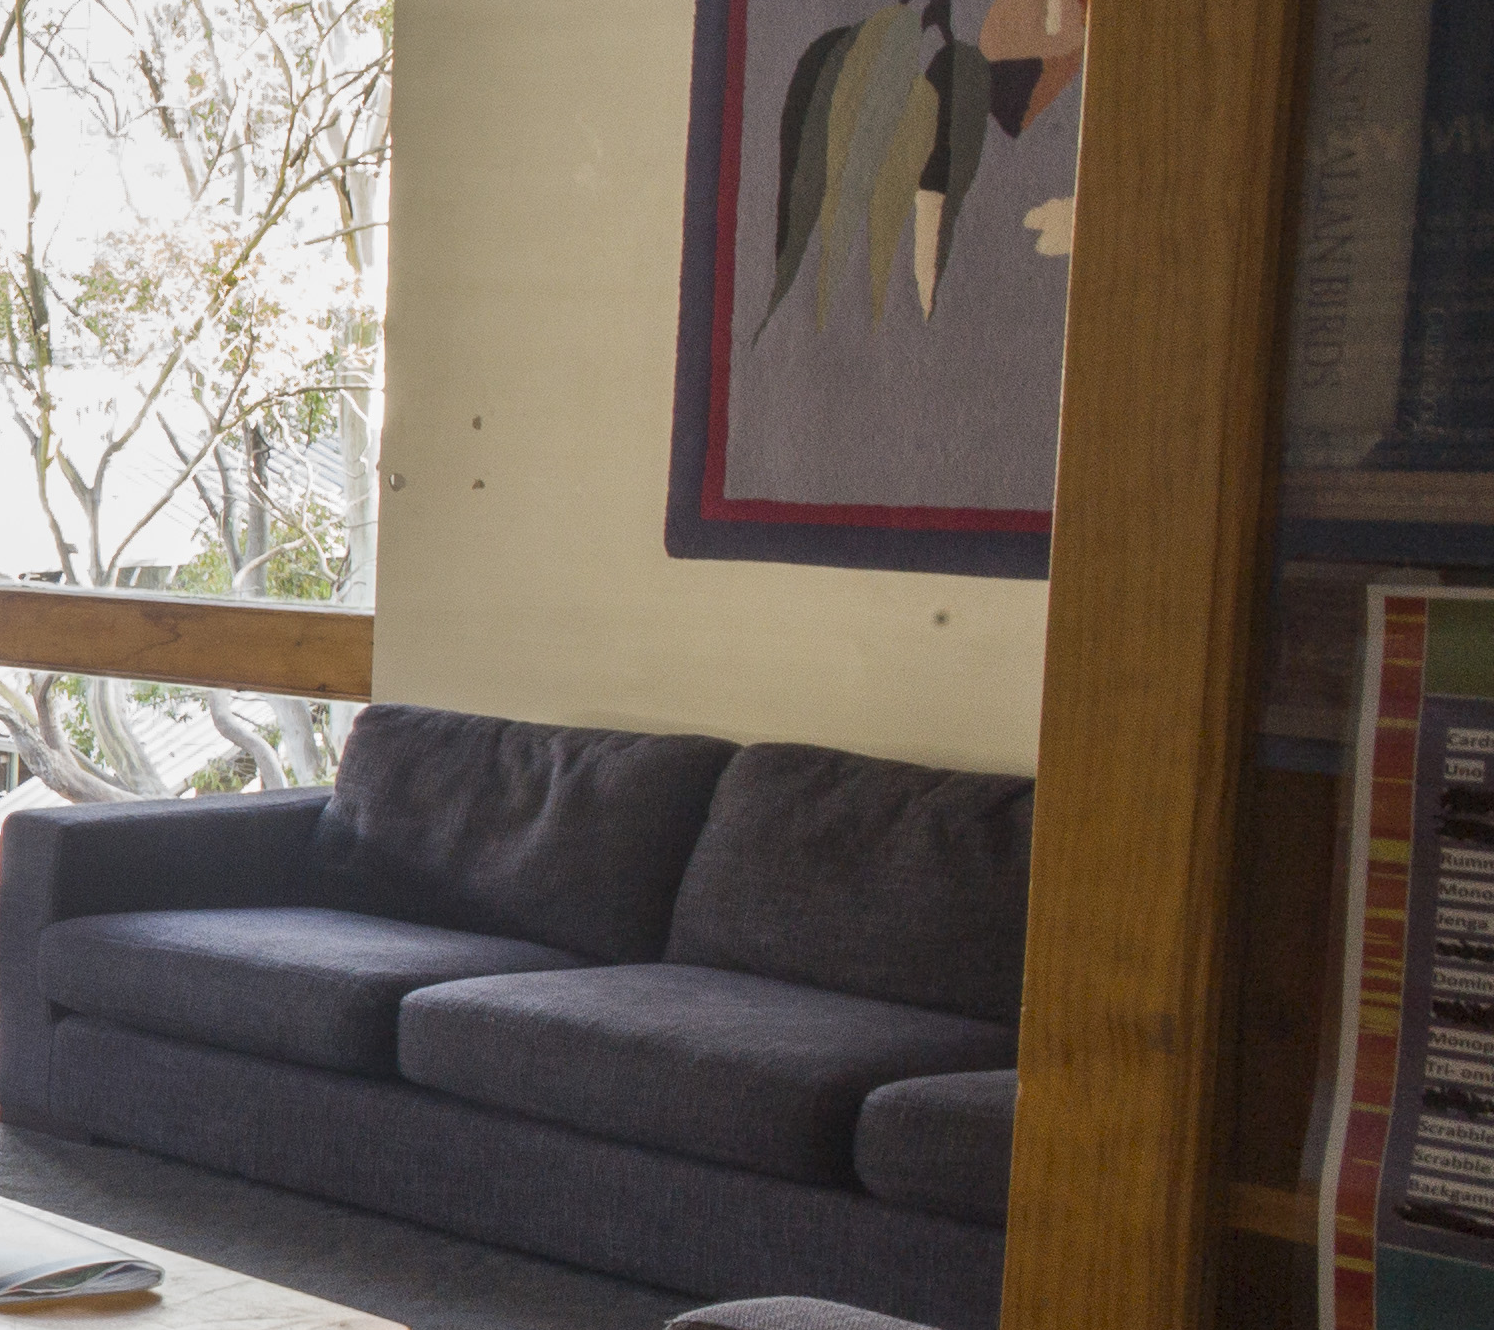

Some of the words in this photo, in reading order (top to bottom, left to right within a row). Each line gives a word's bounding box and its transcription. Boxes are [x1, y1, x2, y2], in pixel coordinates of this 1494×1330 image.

[1302, 276, 1351, 390] BIRDS
[1445, 763, 1482, 778] Uno
[1438, 913, 1489, 932] Jenga
[1414, 1148, 1492, 1174] Scrabble
